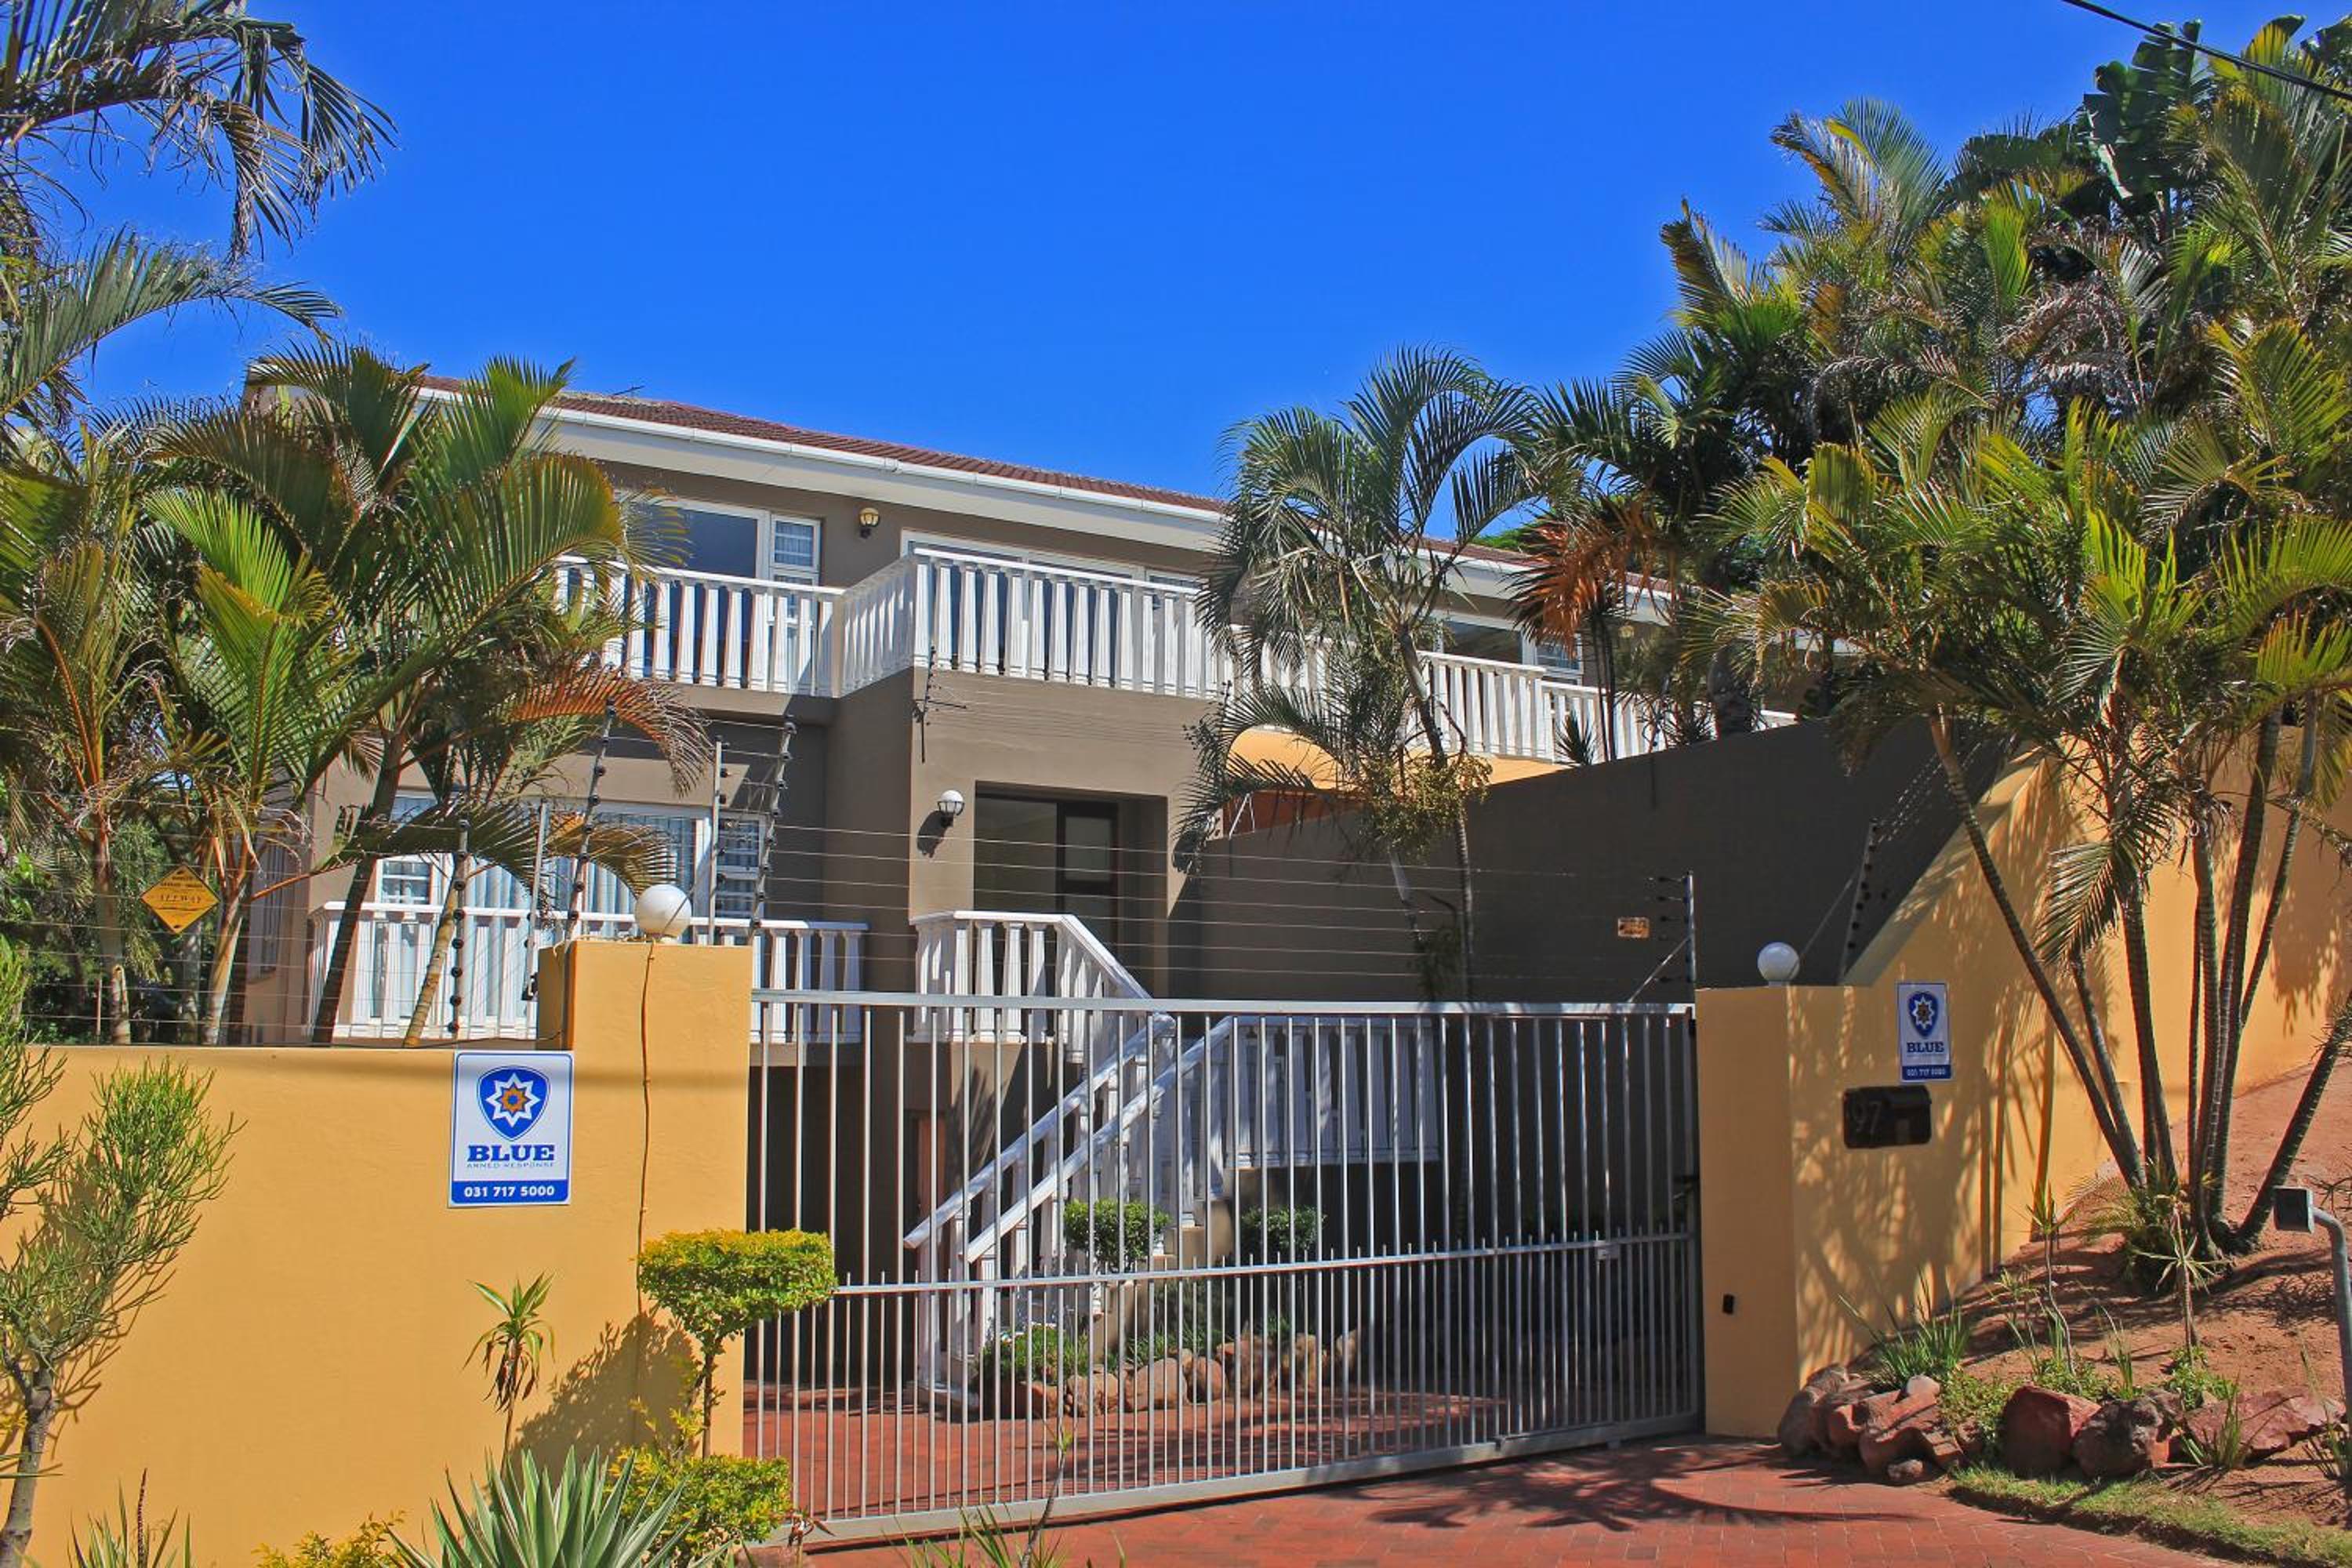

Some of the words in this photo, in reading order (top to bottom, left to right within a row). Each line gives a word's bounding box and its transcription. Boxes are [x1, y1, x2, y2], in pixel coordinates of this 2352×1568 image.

[1907, 1042, 1944, 1053] BLUE
[467, 1145, 554, 1161] BLUE
[464, 1186, 488, 1197] 031
[493, 1185, 516, 1197] 717
[520, 1185, 555, 1197] 5000
